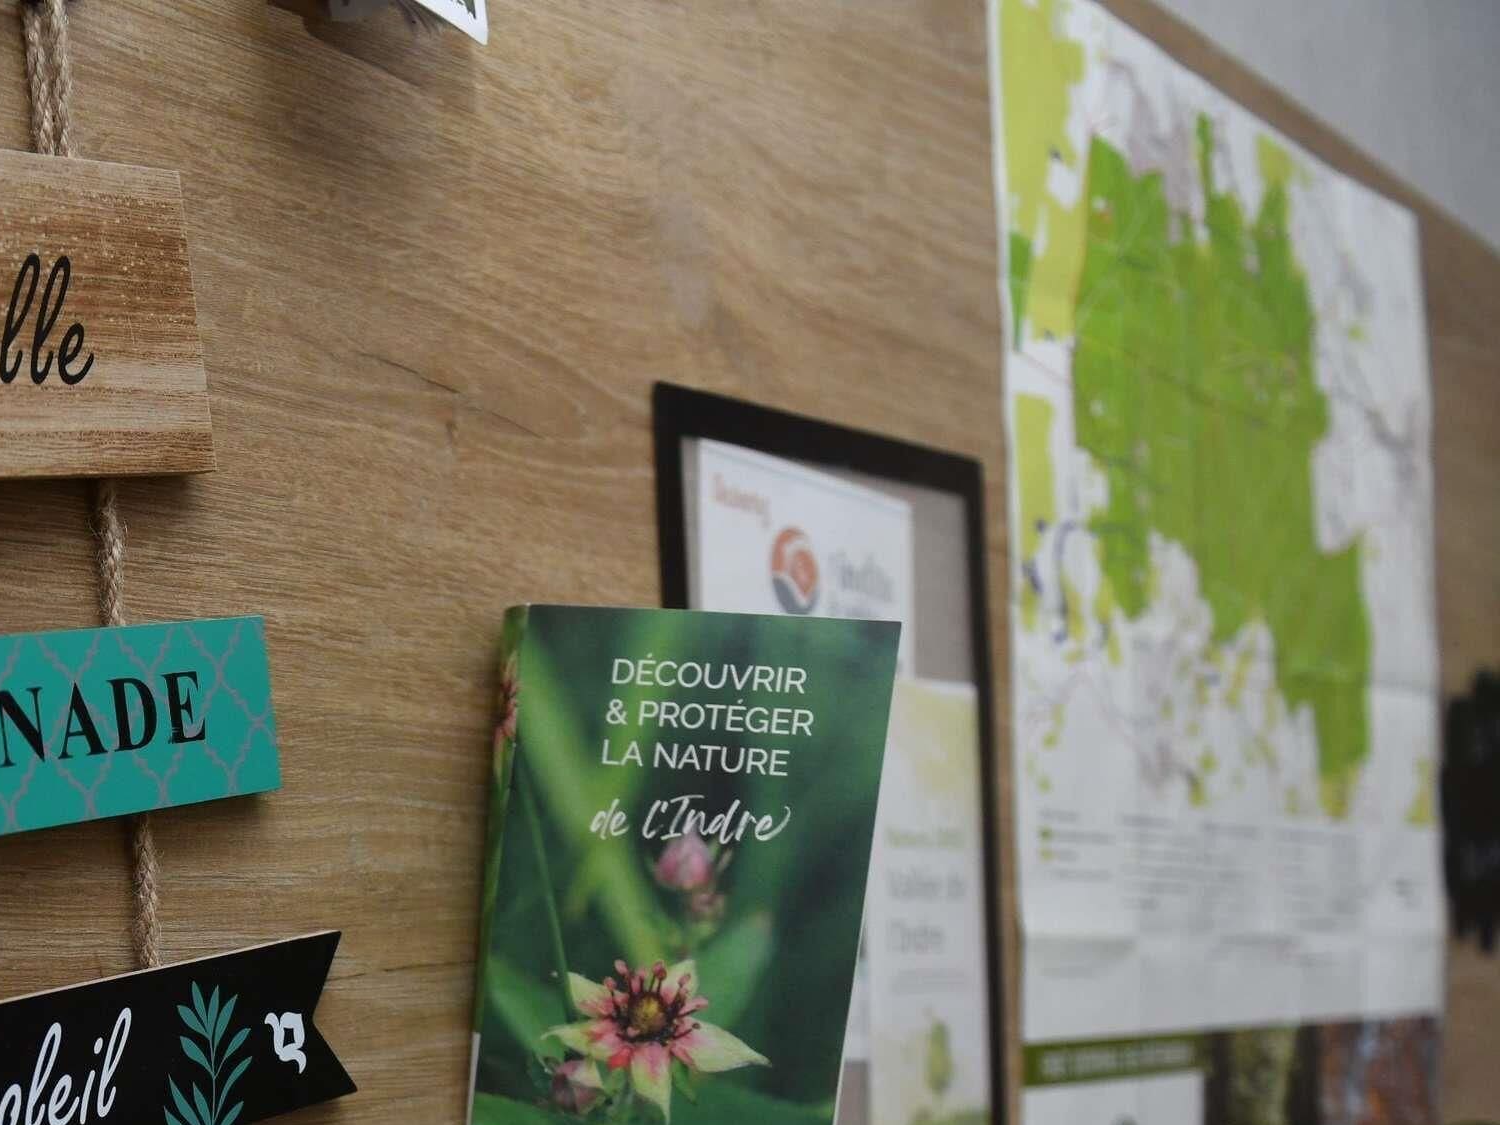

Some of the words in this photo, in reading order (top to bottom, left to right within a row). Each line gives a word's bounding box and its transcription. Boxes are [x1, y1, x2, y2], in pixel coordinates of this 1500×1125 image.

[611, 652, 807, 694] DÉCOUVRIR
[605, 698, 628, 725] &
[638, 699, 814, 736] PROTÉGER
[601, 739, 643, 767] LA
[653, 742, 791, 777] NATURE
[590, 798, 629, 840] de
